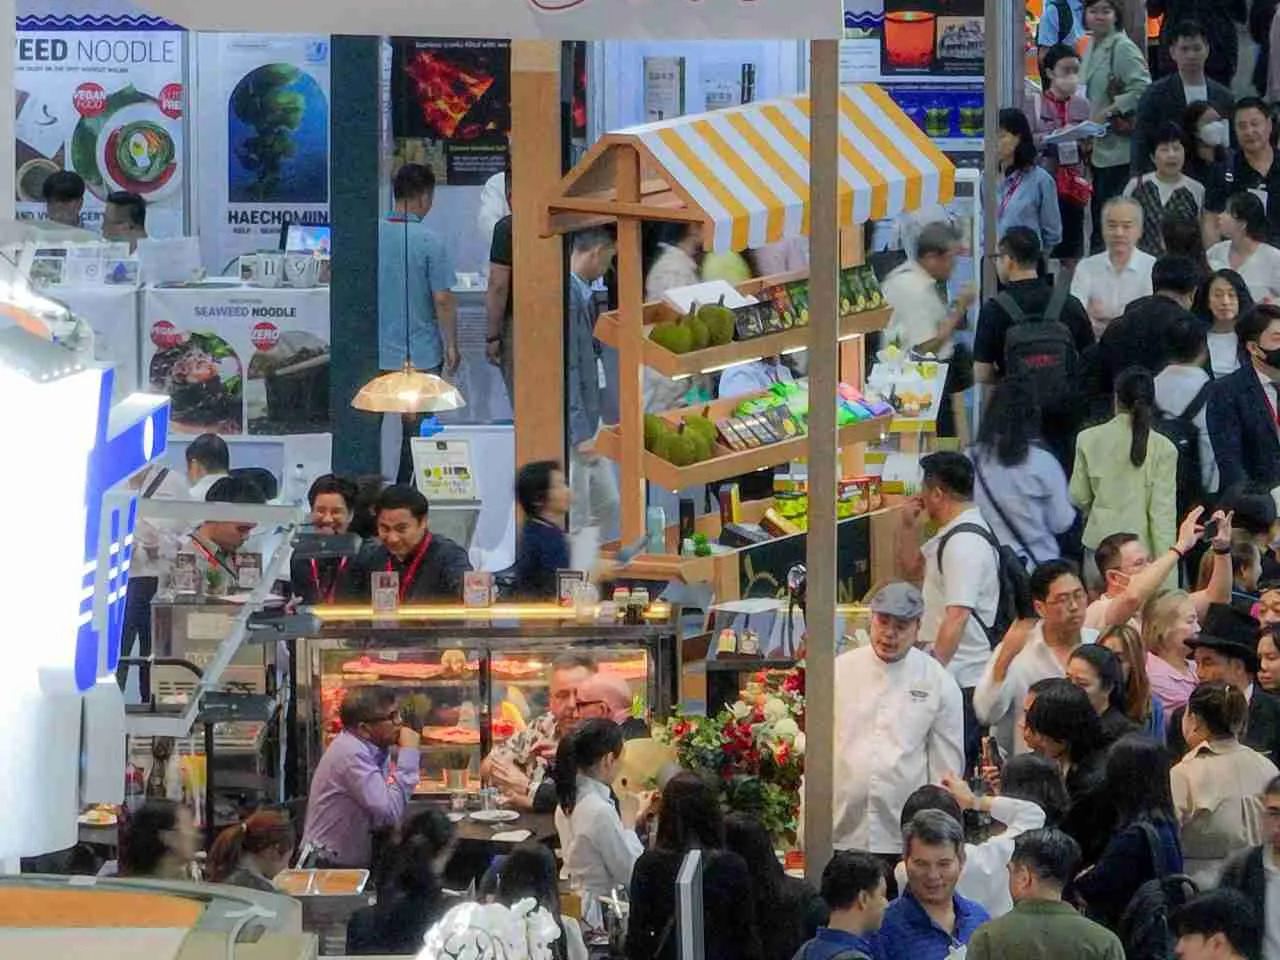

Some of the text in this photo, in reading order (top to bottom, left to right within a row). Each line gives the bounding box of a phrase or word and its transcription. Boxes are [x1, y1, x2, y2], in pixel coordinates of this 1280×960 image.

[78, 41, 176, 63] NOODLE
[195, 306, 296, 317] SEAWEED NOODLE
